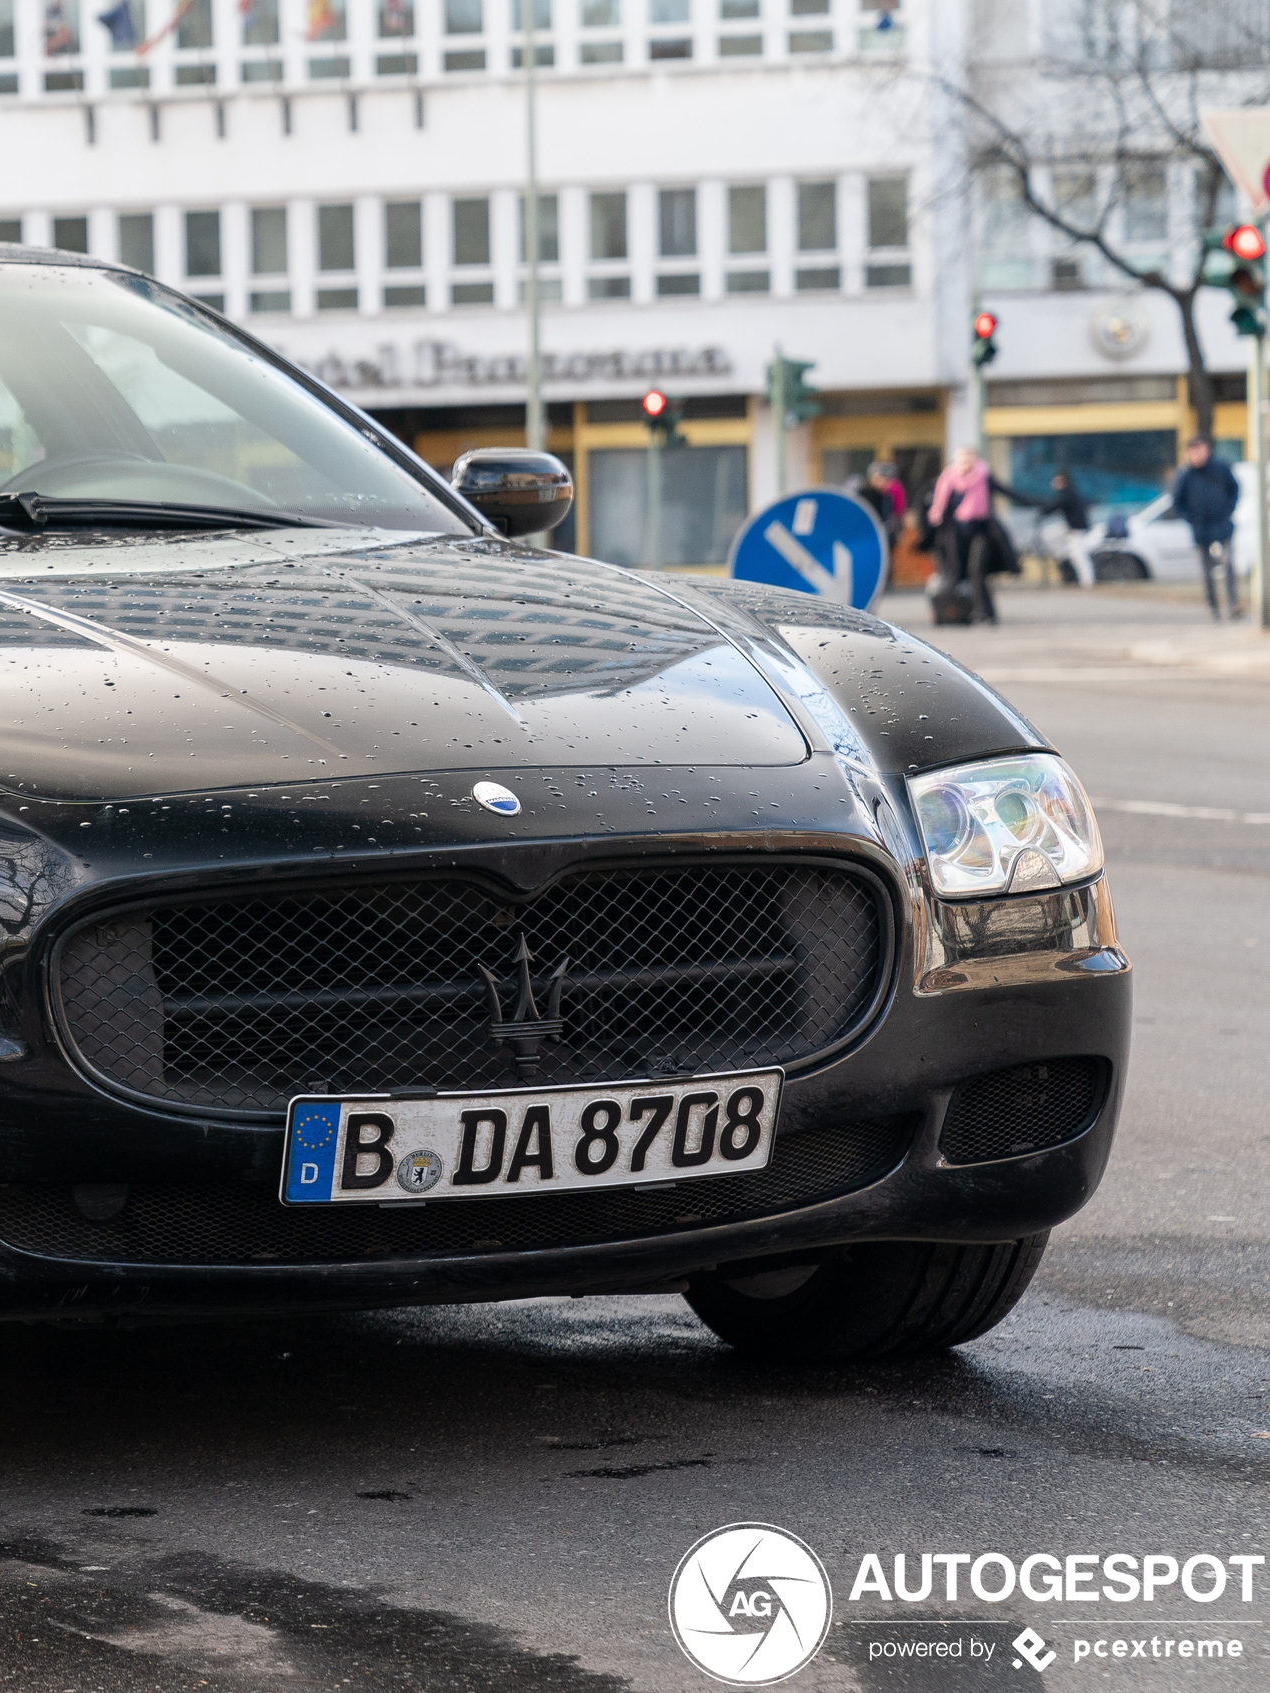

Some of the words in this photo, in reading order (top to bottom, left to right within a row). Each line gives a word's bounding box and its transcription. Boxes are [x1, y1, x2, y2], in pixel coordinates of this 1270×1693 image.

[340, 1112, 395, 1191] B
[452, 1105, 554, 1186] DA
[574, 1086, 765, 1176] 8708
[300, 1163, 318, 1184] D
